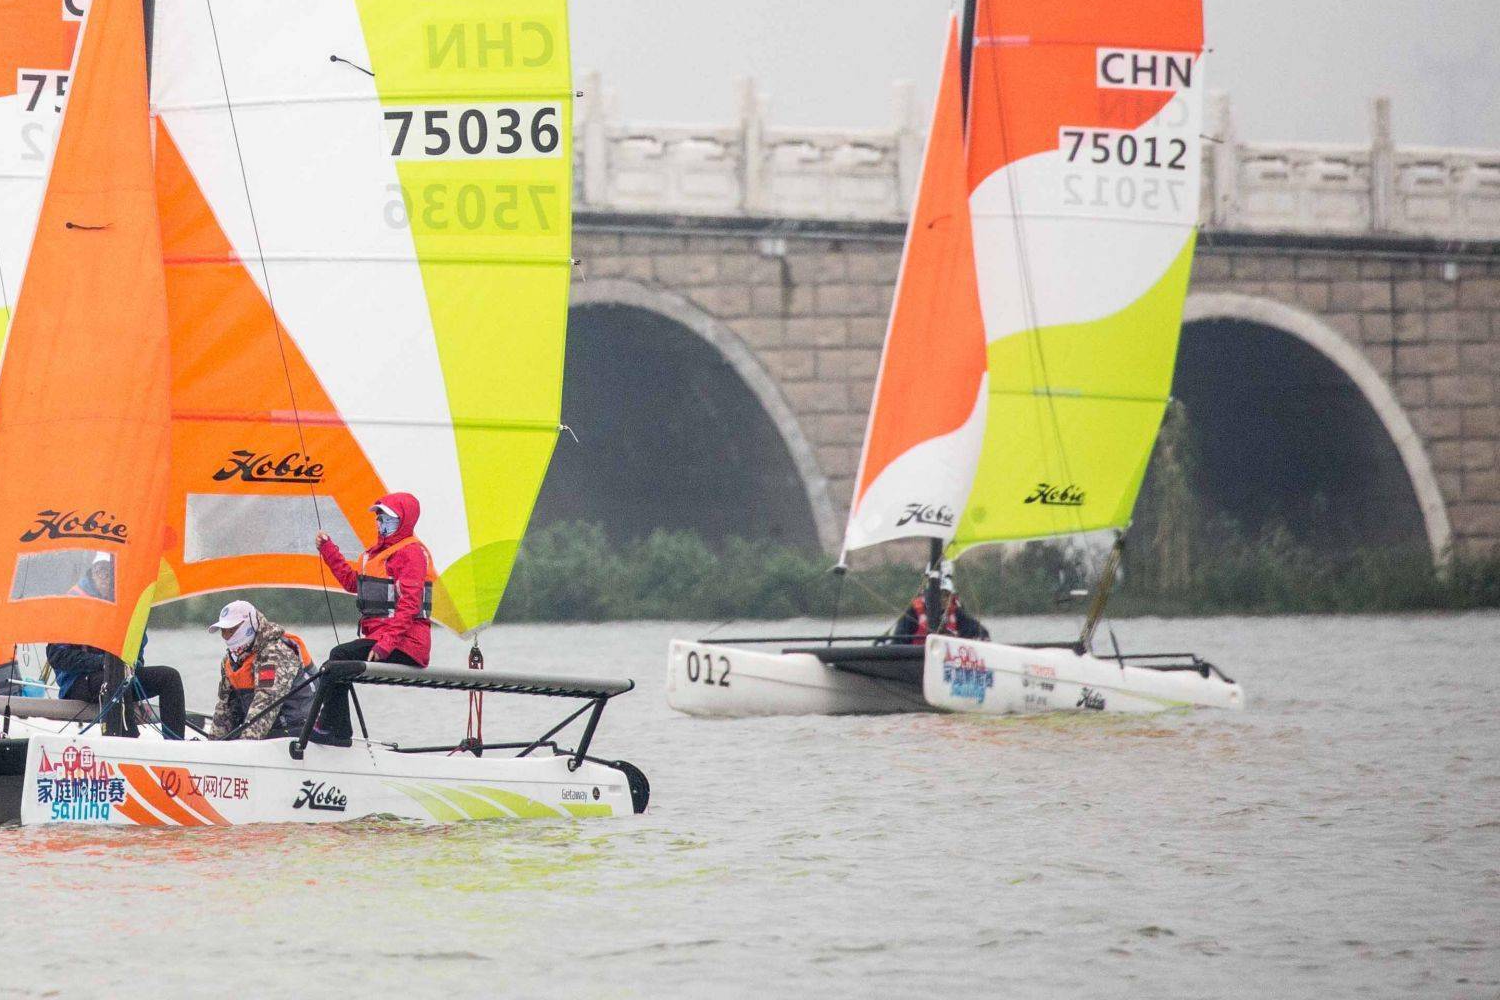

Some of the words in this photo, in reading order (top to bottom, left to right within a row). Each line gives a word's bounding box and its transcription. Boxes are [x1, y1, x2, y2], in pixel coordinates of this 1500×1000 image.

[1101, 53, 1192, 88] CHN
[384, 107, 560, 156] 75036
[1063, 131, 1187, 171] 75012
[211, 450, 324, 484] Hobie
[1023, 483, 1084, 506] Hobie
[19, 509, 128, 545] Hobie
[687, 650, 731, 688] 012
[63, 746, 95, 772] 中国
[36, 777, 126, 803] 家庭帆船赛
[187, 774, 249, 800] 文网亿联
[292, 779, 348, 812] Hobie
[561, 788, 589, 803] Getaway
